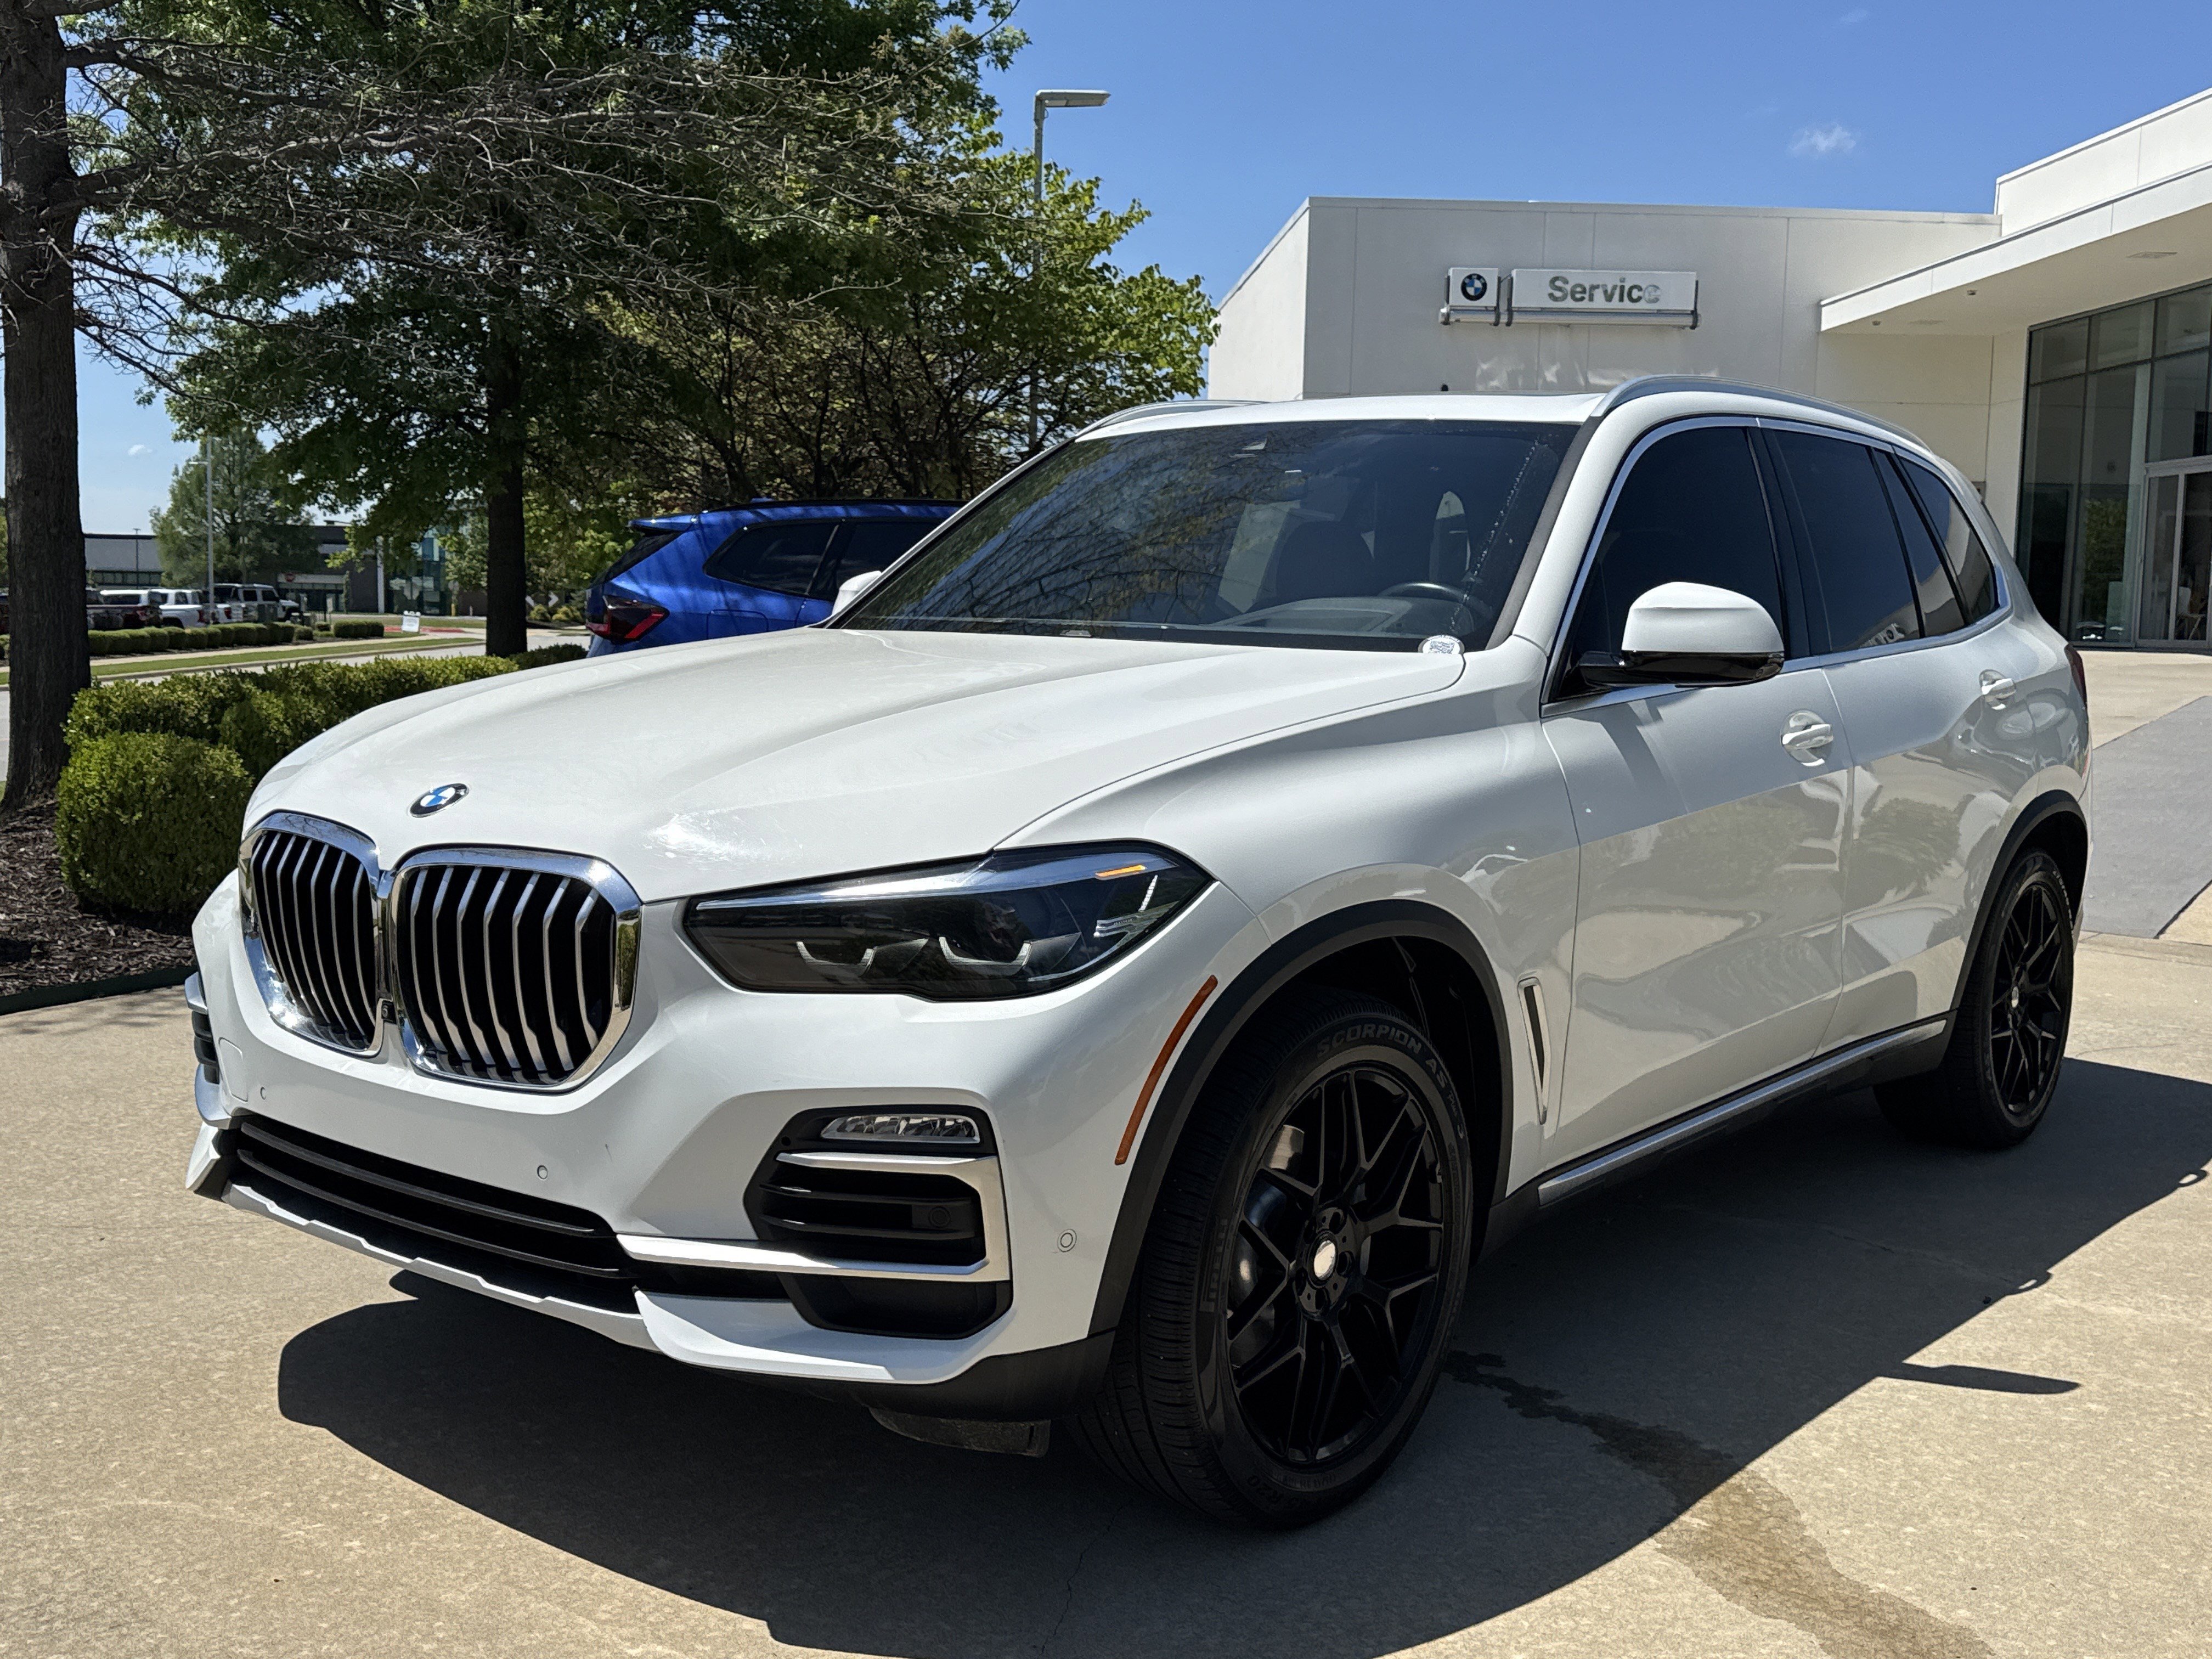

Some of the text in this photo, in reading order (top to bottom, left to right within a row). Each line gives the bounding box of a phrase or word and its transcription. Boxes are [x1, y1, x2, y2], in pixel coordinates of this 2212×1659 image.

[1548, 275, 1661, 303] Service
[1317, 1024, 1422, 1056] SCORPION
[1425, 1058, 1448, 1089] AS
[1457, 1122, 1465, 1139] 3
